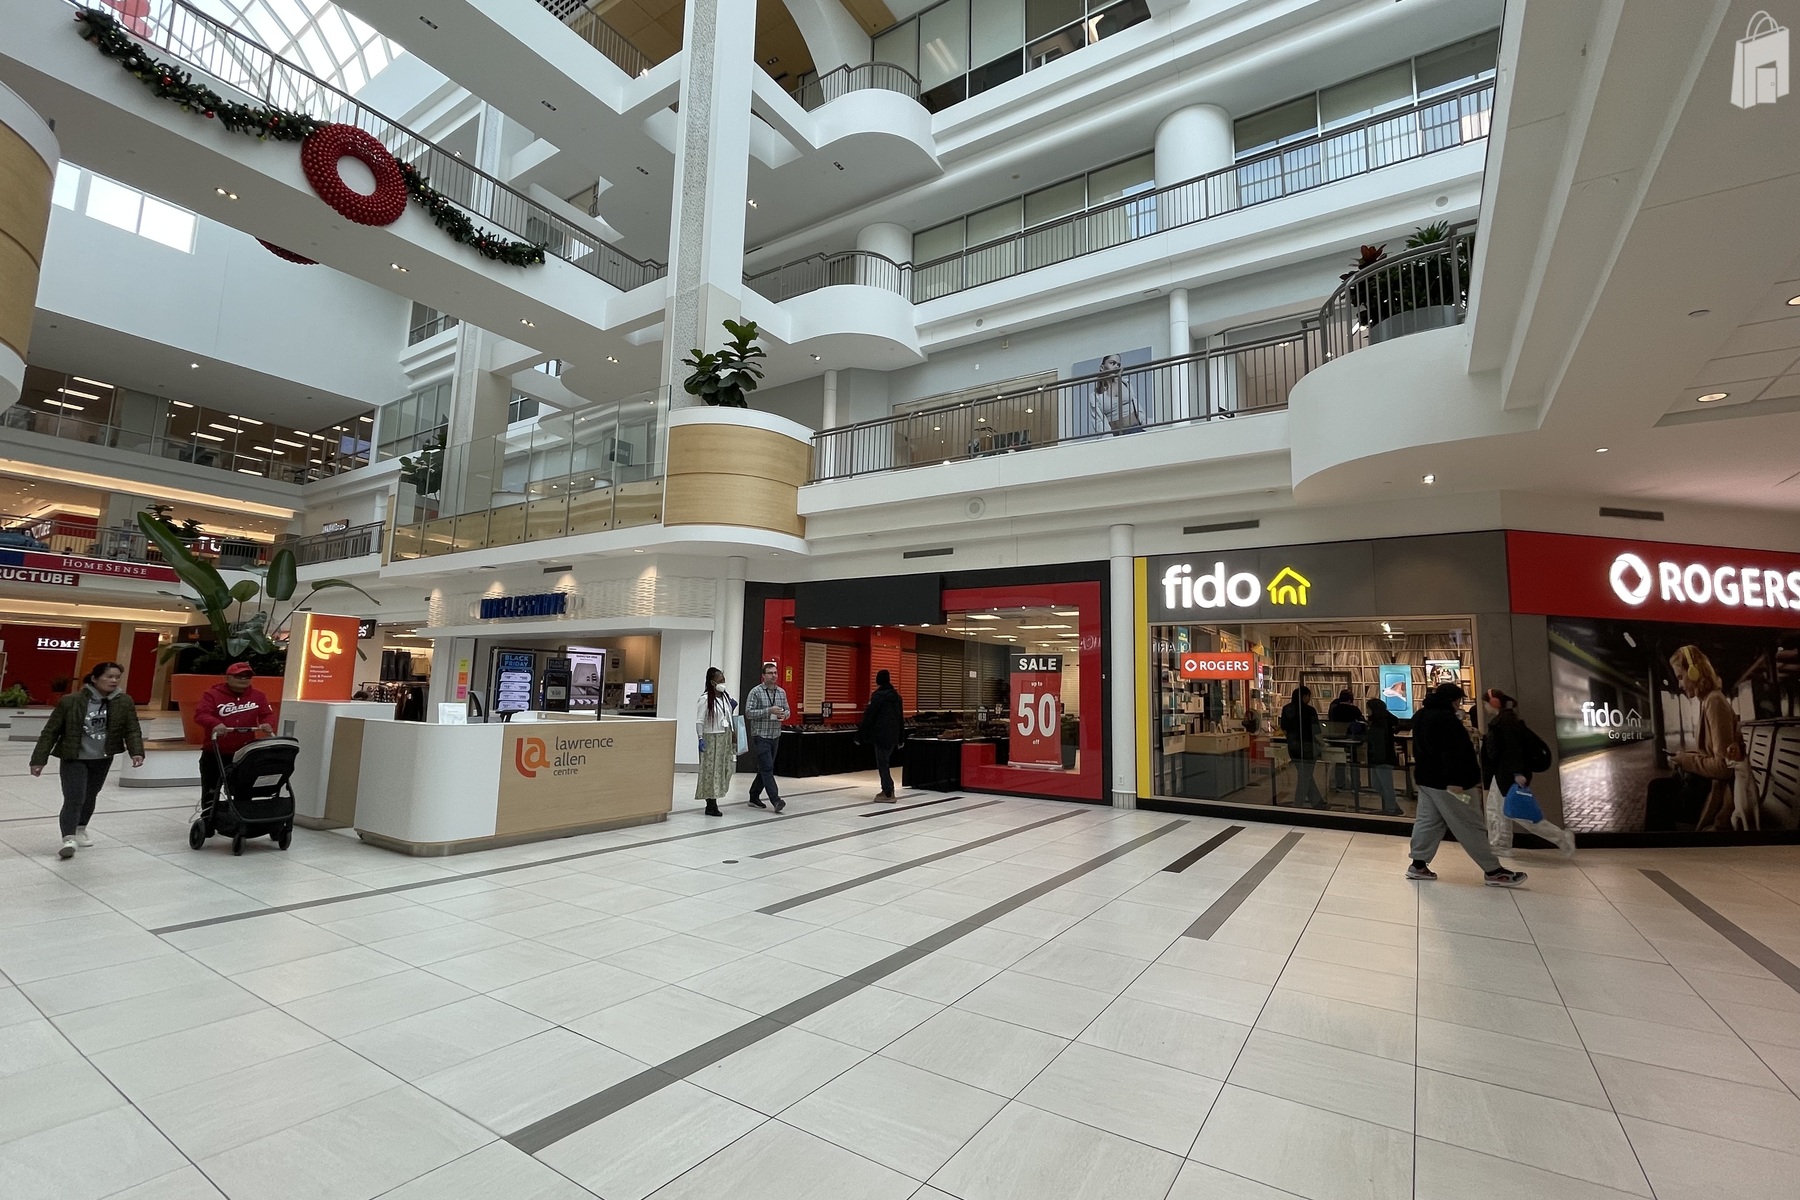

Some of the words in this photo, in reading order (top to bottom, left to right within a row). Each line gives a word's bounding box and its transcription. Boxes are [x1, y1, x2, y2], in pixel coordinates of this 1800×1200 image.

[1161, 562, 1261, 609] fido
[504, 654, 529, 662] BLACK
[504, 660, 528, 668] FRIDAY
[1019, 657, 1057, 671] SALE
[1199, 660, 1249, 671] ROGERS
[216, 701, 259, 717] Canada
[1581, 701, 1624, 727] fido
[1608, 729, 1620, 739] Go
[1621, 731, 1635, 741] get
[555, 736, 614, 751] lawrence
[553, 752, 586, 767] allen
[553, 768, 579, 776] centre
